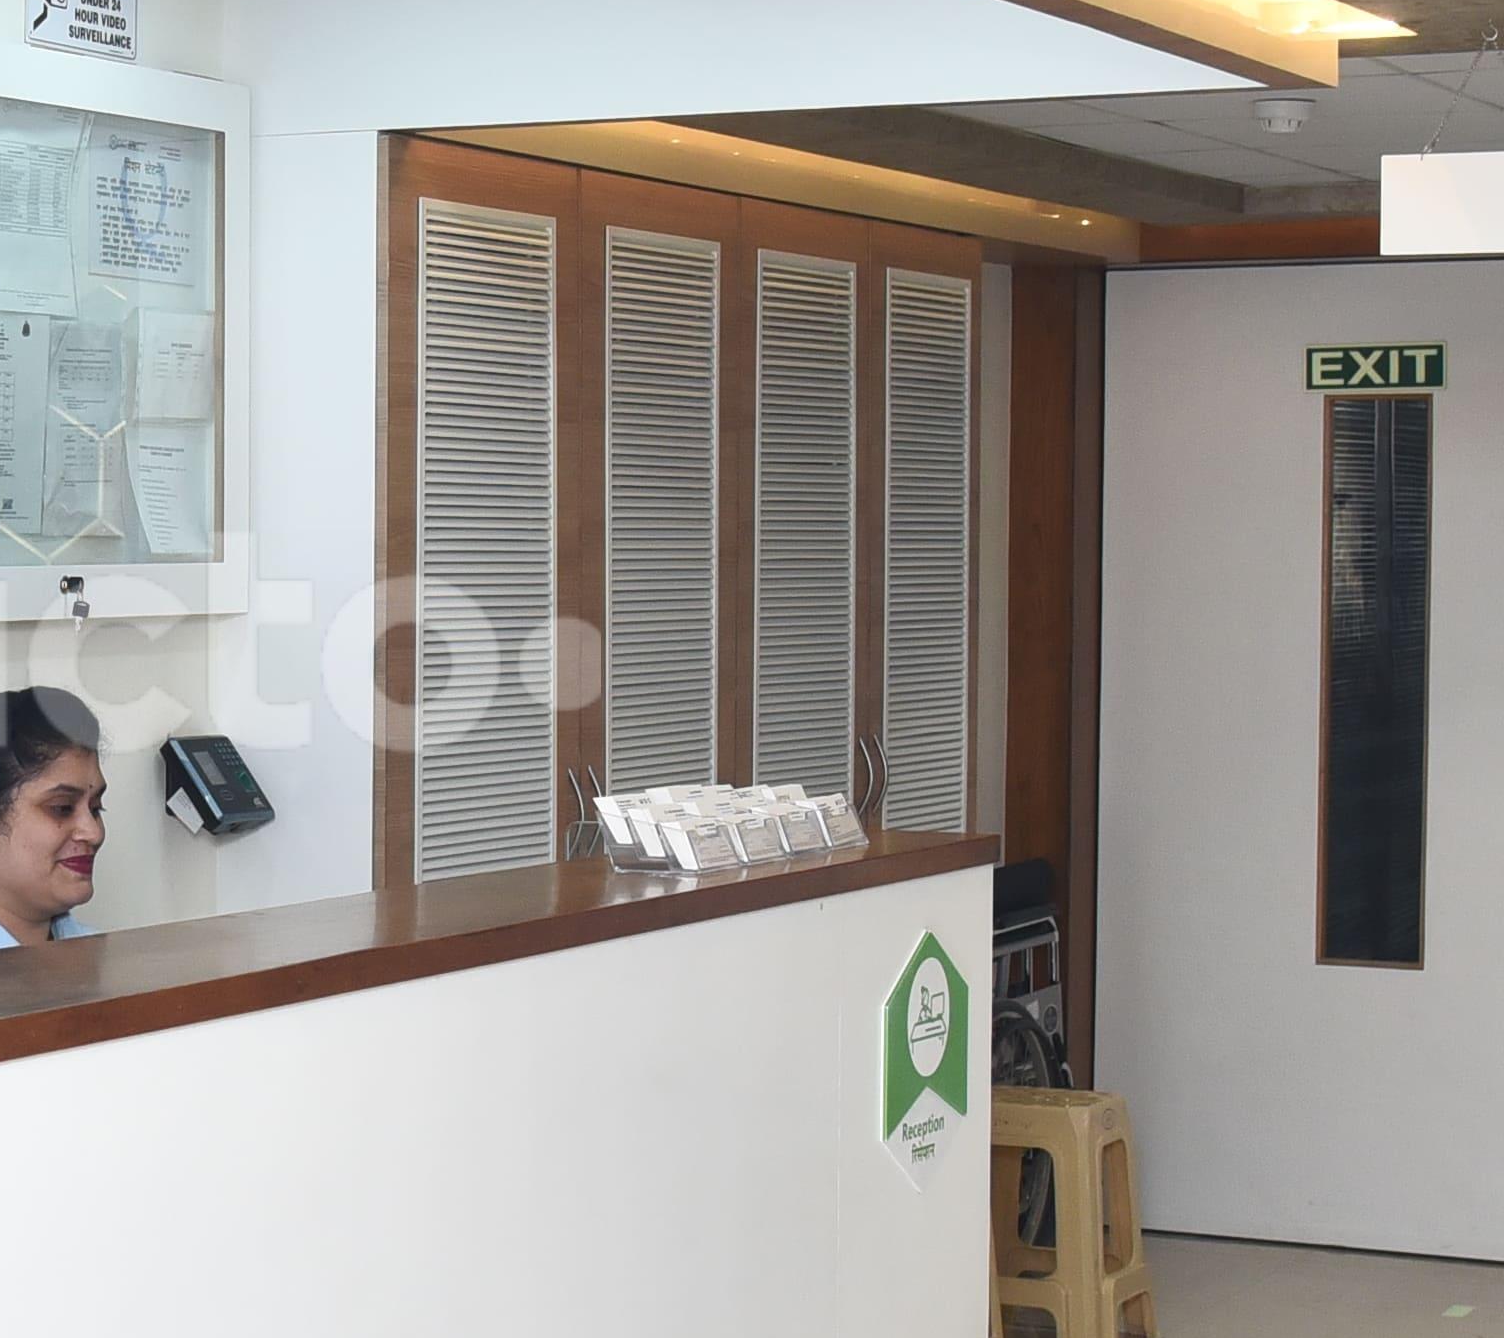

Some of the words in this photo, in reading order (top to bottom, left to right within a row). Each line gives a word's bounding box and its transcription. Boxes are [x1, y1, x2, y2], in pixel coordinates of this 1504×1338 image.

[75, 8, 99, 25] HOUR
[101, 14, 126, 31] VIDEO
[68, 24, 132, 50] SURVEILLANCE
[1312, 349, 1438, 386] EXIT
[902, 1113, 944, 1141] Reception
